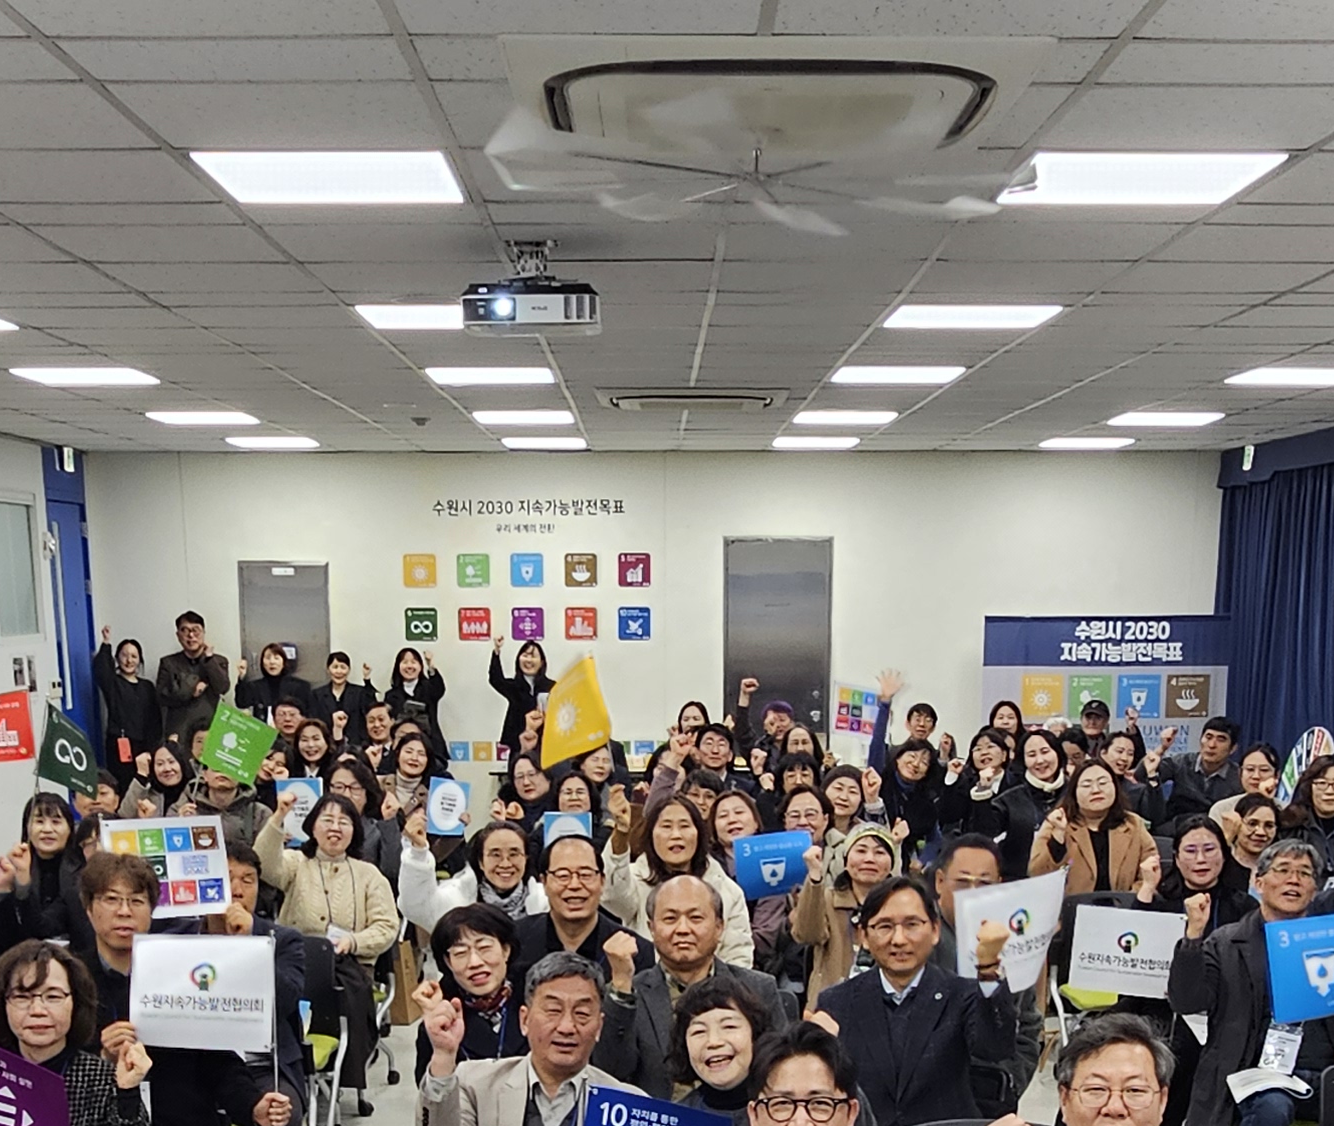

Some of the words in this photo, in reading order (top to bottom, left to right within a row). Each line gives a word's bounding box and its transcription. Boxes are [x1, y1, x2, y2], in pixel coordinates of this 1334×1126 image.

[432, 499, 473, 517] 수원시
[477, 499, 514, 515] 2030
[517, 498, 626, 516] 지속가능발전목표
[1074, 621, 1122, 640] 수원시
[1124, 621, 1170, 640] 2030
[1060, 642, 1183, 662] 지속가능발전목표
[220, 710, 231, 722] 2
[743, 843, 751, 857] 3
[1279, 930, 1290, 948] 3
[139, 994, 264, 1013] 수원지속가능발전협의회
[631, 1108, 659, 1122] 자치를
[660, 1113, 679, 1126] 통한
